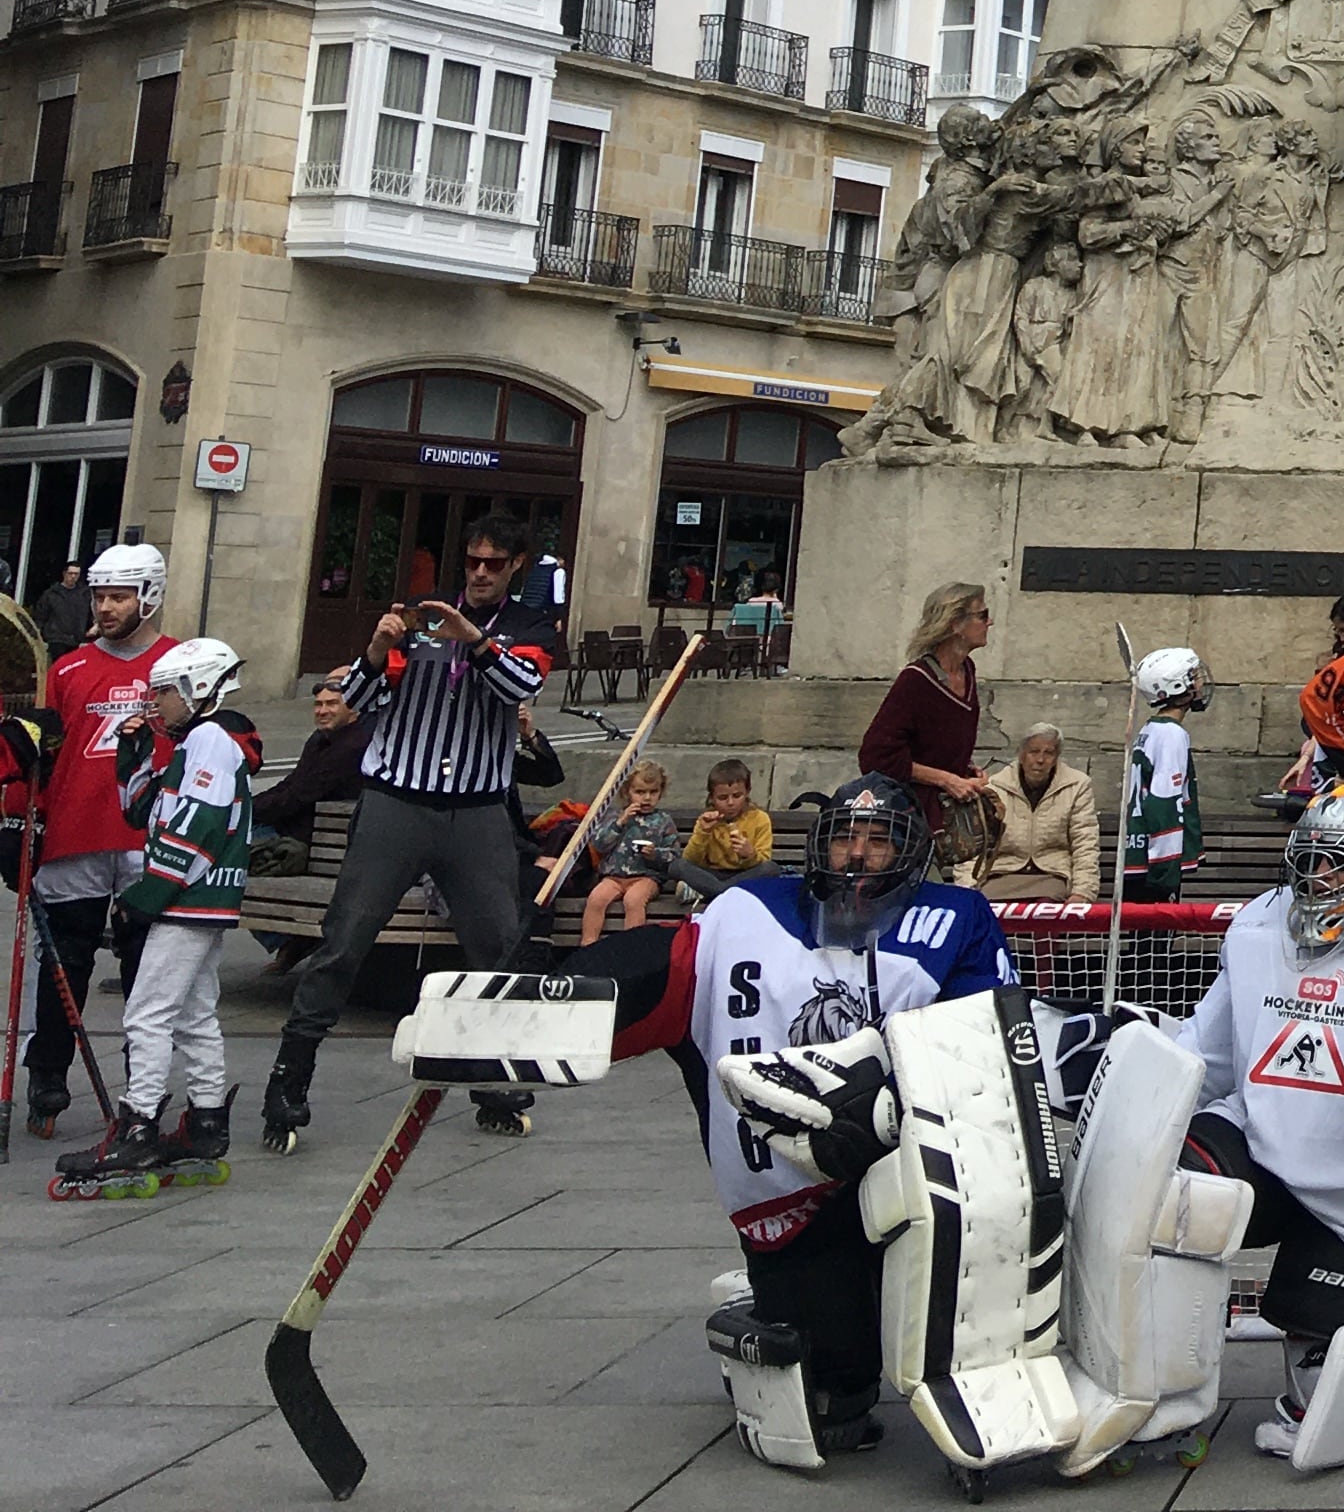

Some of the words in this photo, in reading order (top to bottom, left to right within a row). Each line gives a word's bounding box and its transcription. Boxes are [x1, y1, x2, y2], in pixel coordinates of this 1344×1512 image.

[896, 904, 957, 950] 00
[989, 901, 1093, 921] AUER
[1302, 980, 1333, 997] SOS
[1262, 995, 1323, 1016] HOCKEY
[1071, 1055, 1113, 1161] BAUER
[1033, 1082, 1062, 1180] WARRIOR
